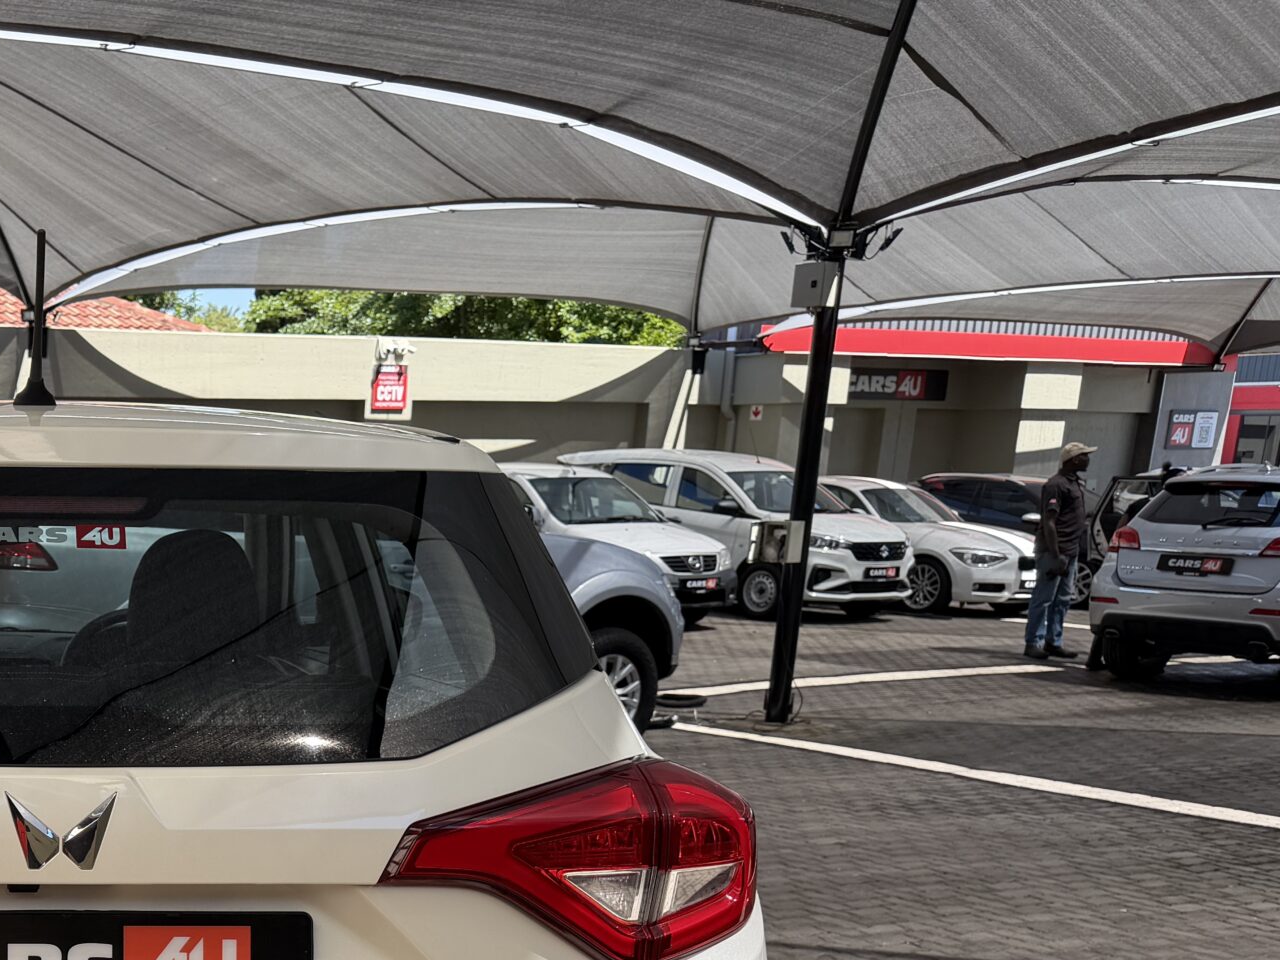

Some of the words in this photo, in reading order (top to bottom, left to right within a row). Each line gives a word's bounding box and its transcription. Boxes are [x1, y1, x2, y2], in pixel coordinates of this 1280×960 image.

[376, 385, 405, 401] CCTV
[848, 375, 897, 393] CARS
[898, 375, 922, 396] 4U
[1172, 414, 1195, 423] CARS
[1171, 426, 1189, 444] 4U
[80, 526, 121, 546] 4U
[1168, 558, 1202, 568] CARS
[1203, 560, 1222, 570] 4U
